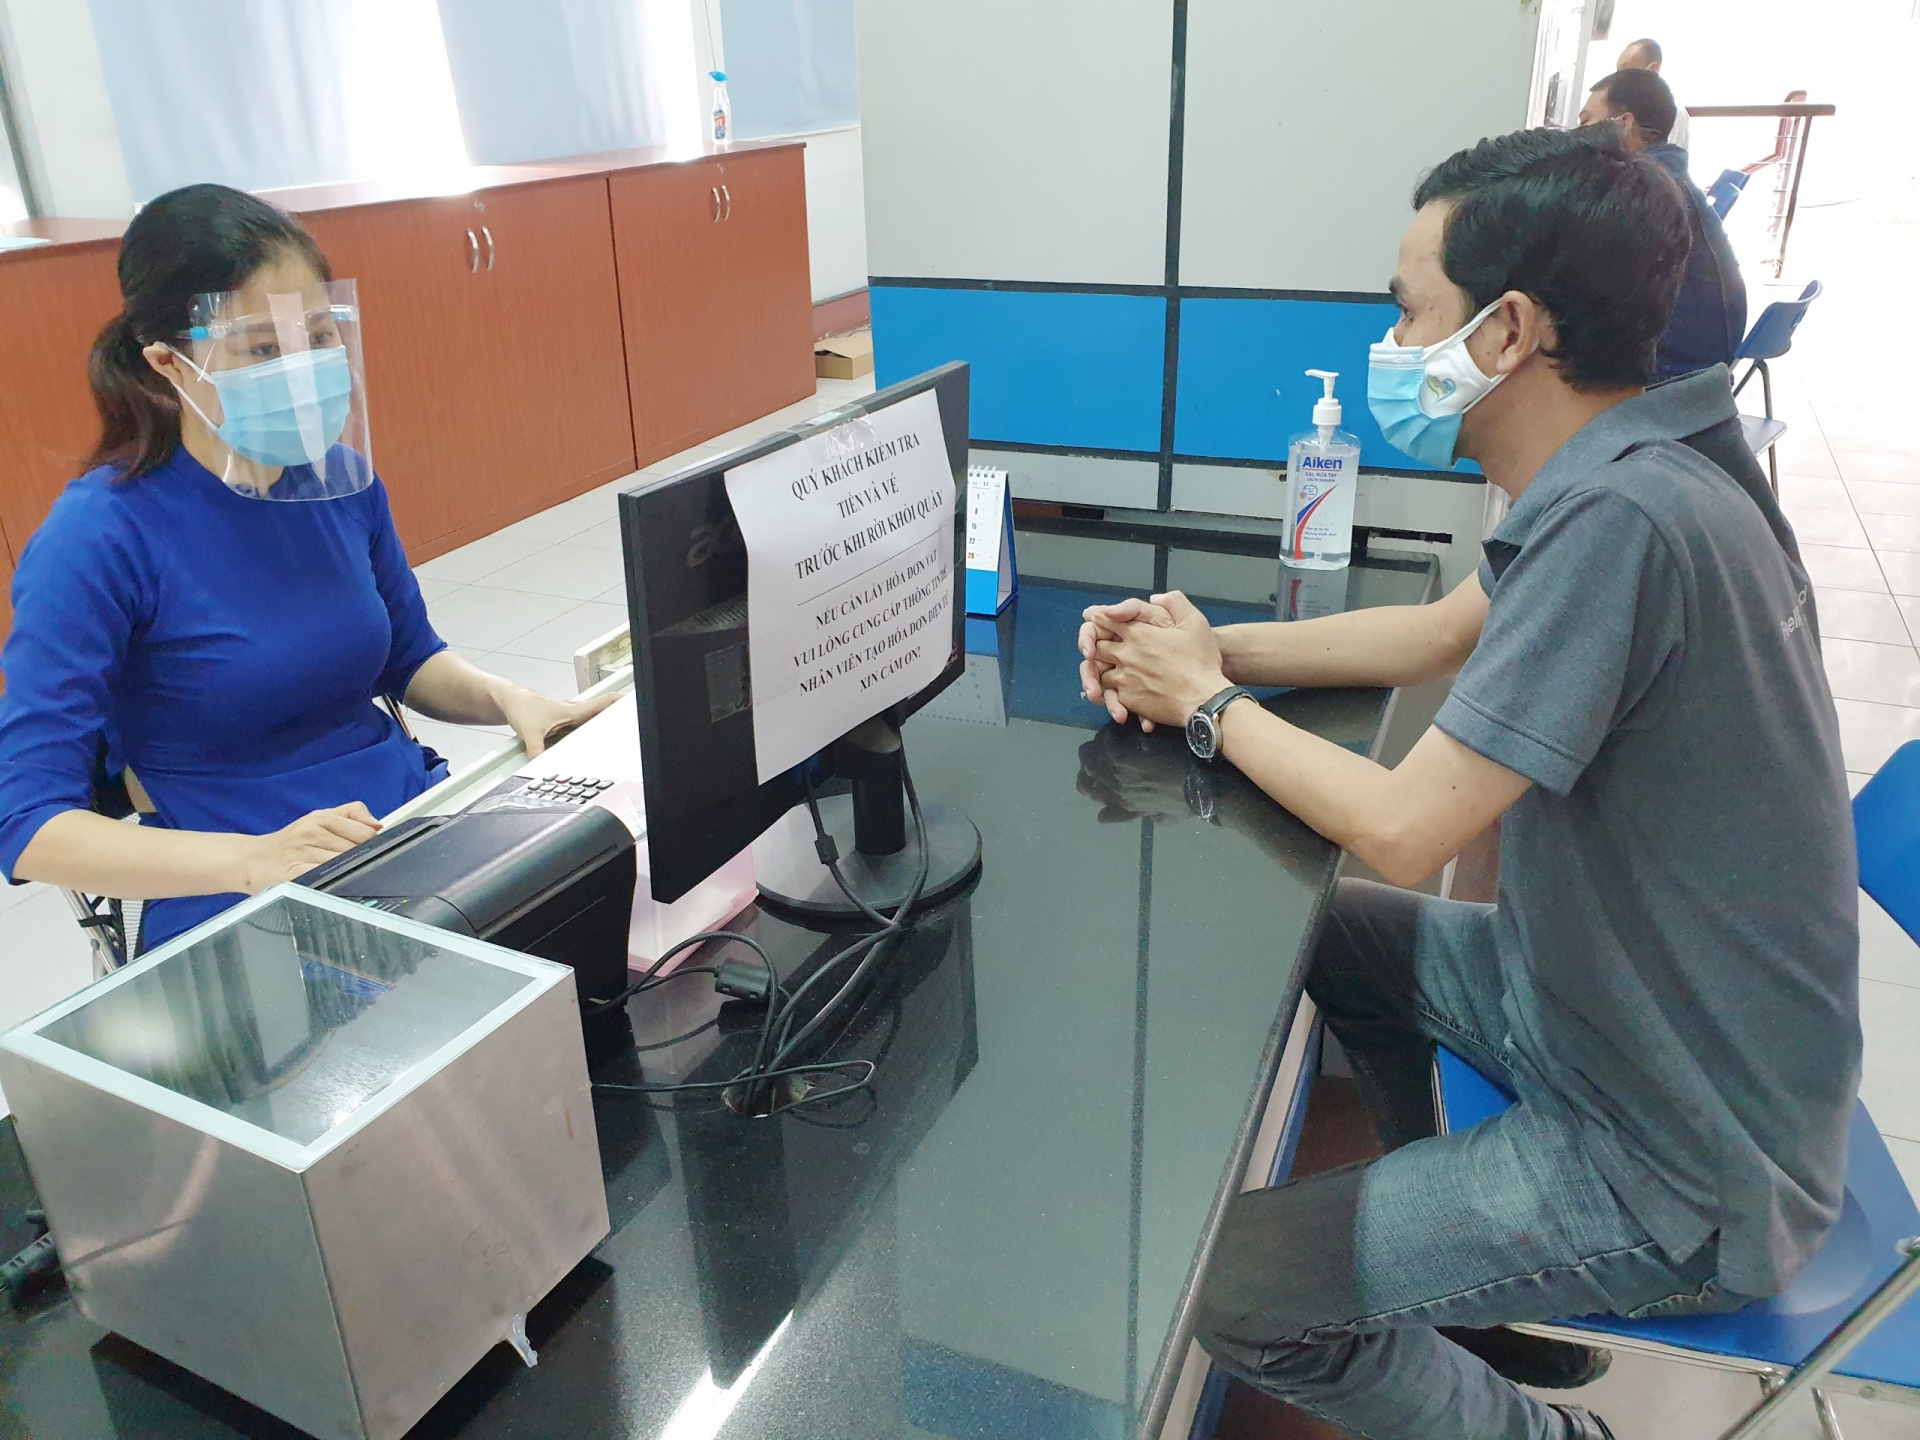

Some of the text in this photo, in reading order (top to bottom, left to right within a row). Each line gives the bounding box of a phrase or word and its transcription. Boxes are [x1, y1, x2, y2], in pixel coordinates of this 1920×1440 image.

[791, 468, 819, 501] QUÝ
[822, 457, 864, 486] KHÁCH
[897, 432, 921, 454] TRA
[864, 480, 881, 504] VÀ
[882, 472, 899, 496] VÉ
[1302, 456, 1343, 469] Aiken
[795, 542, 842, 579] TRƯỚC
[843, 531, 866, 556] KHI
[866, 518, 887, 544] RỜI
[887, 503, 917, 533] KHỎI
[886, 570, 906, 592] HÓA
[925, 549, 938, 570] VAT
[794, 648, 816, 669] VUI
[818, 631, 850, 658] LÒNG
[852, 613, 881, 639] CUNG
[902, 583, 932, 611] THÔNG
[800, 668, 834, 697] NHÂN
[837, 652, 863, 677] VIÊN
[865, 639, 886, 660] TẠO
[887, 627, 908, 648] HÓA
[860, 670, 878, 692] XIN
